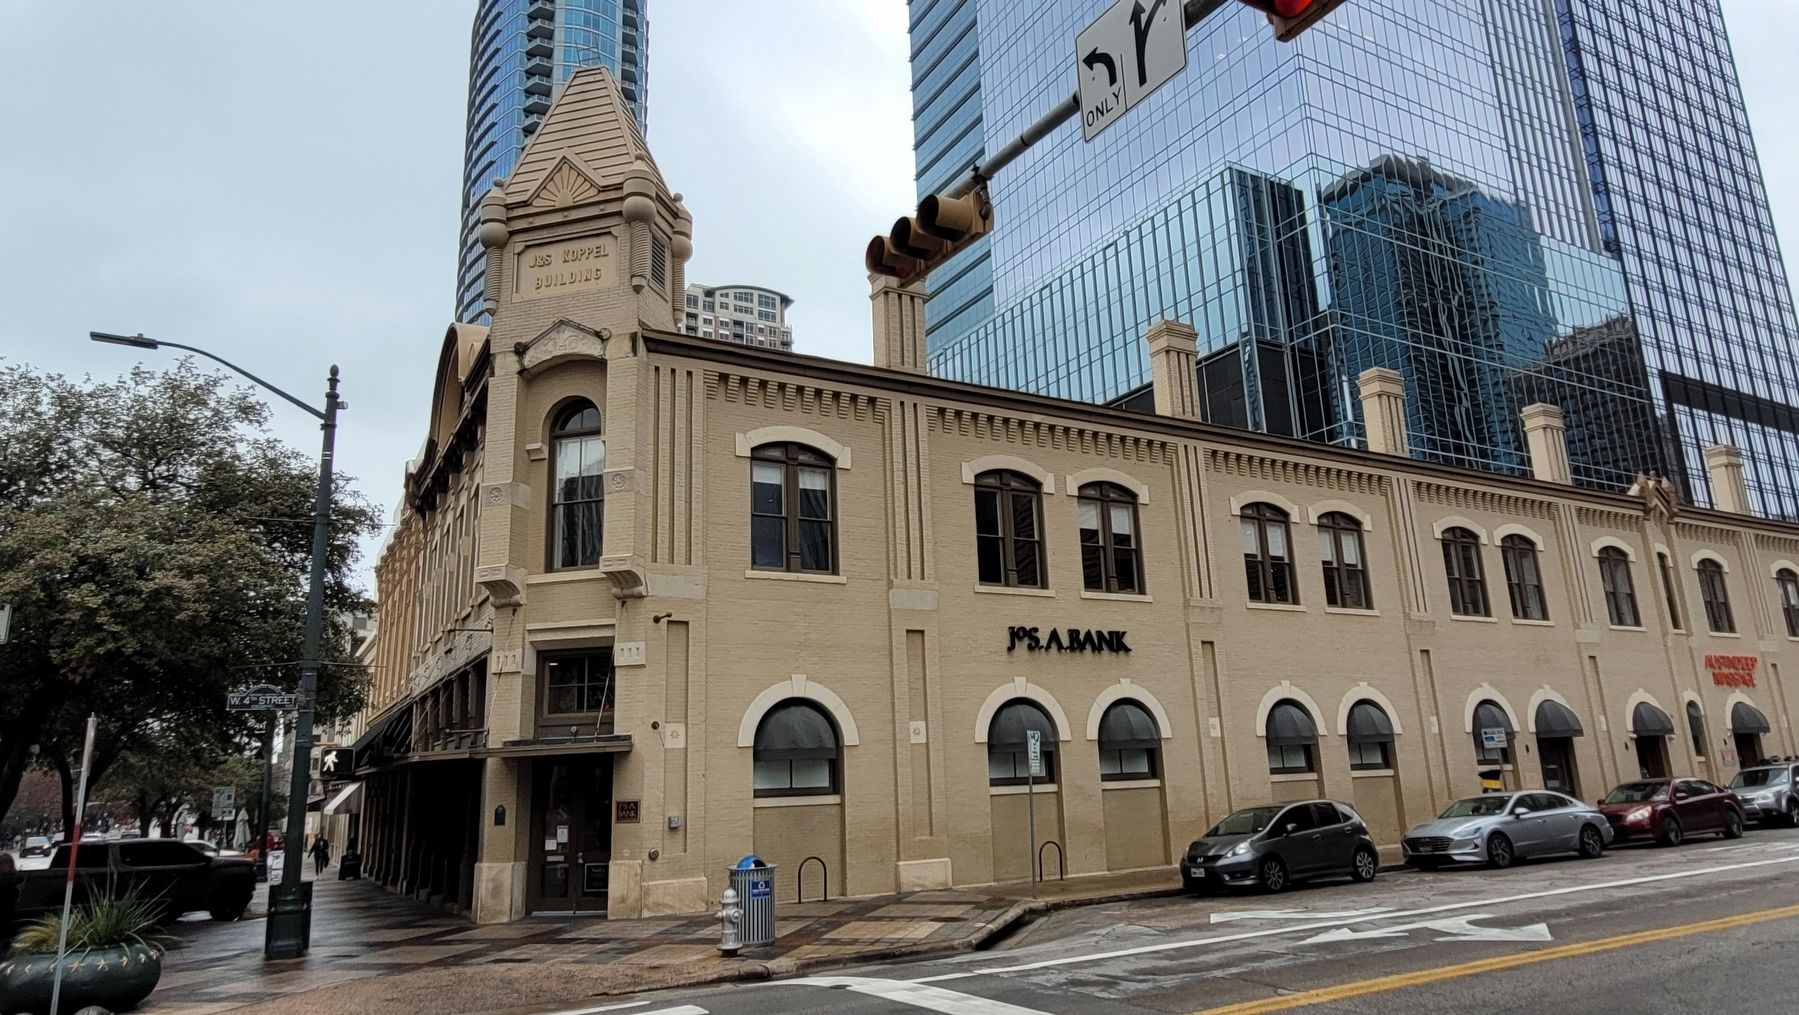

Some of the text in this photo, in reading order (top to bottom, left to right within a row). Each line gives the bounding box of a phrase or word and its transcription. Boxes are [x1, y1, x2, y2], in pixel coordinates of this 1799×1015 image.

[1085, 86, 1122, 127] ONLY
[528, 244, 609, 268] J&S KOPPEL
[535, 267, 602, 290] BUILDING
[259, 696, 296, 705] STREET
